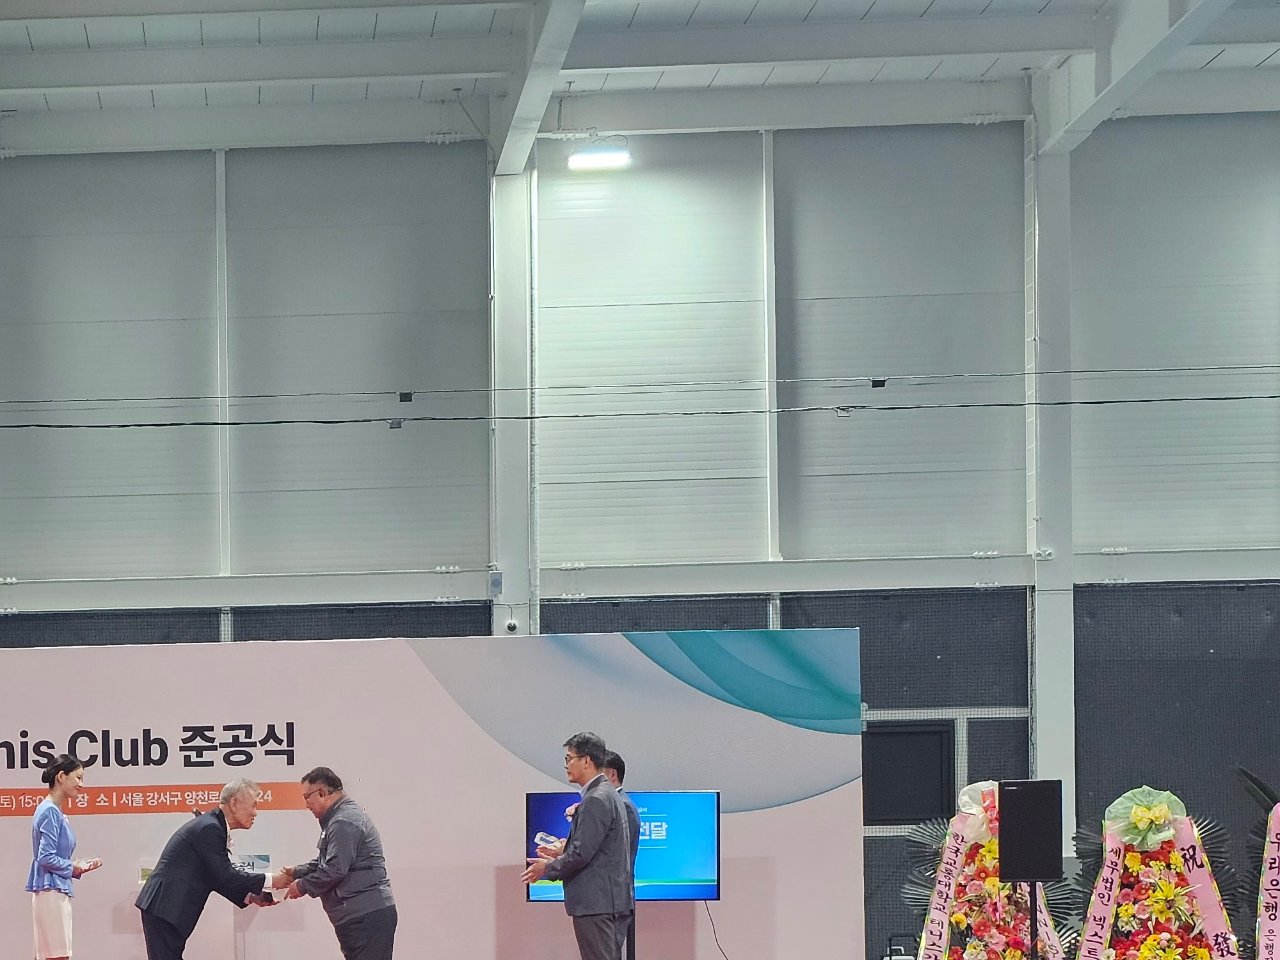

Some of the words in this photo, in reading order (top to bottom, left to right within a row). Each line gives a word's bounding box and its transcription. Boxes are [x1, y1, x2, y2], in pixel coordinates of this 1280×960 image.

[67, 728, 169, 768] Club
[178, 721, 295, 768] 준공식
[19, 794, 44, 808] 15:0
[120, 791, 144, 807] 서울
[146, 791, 182, 806] 강서구
[1180, 844, 1205, 874] 祝
